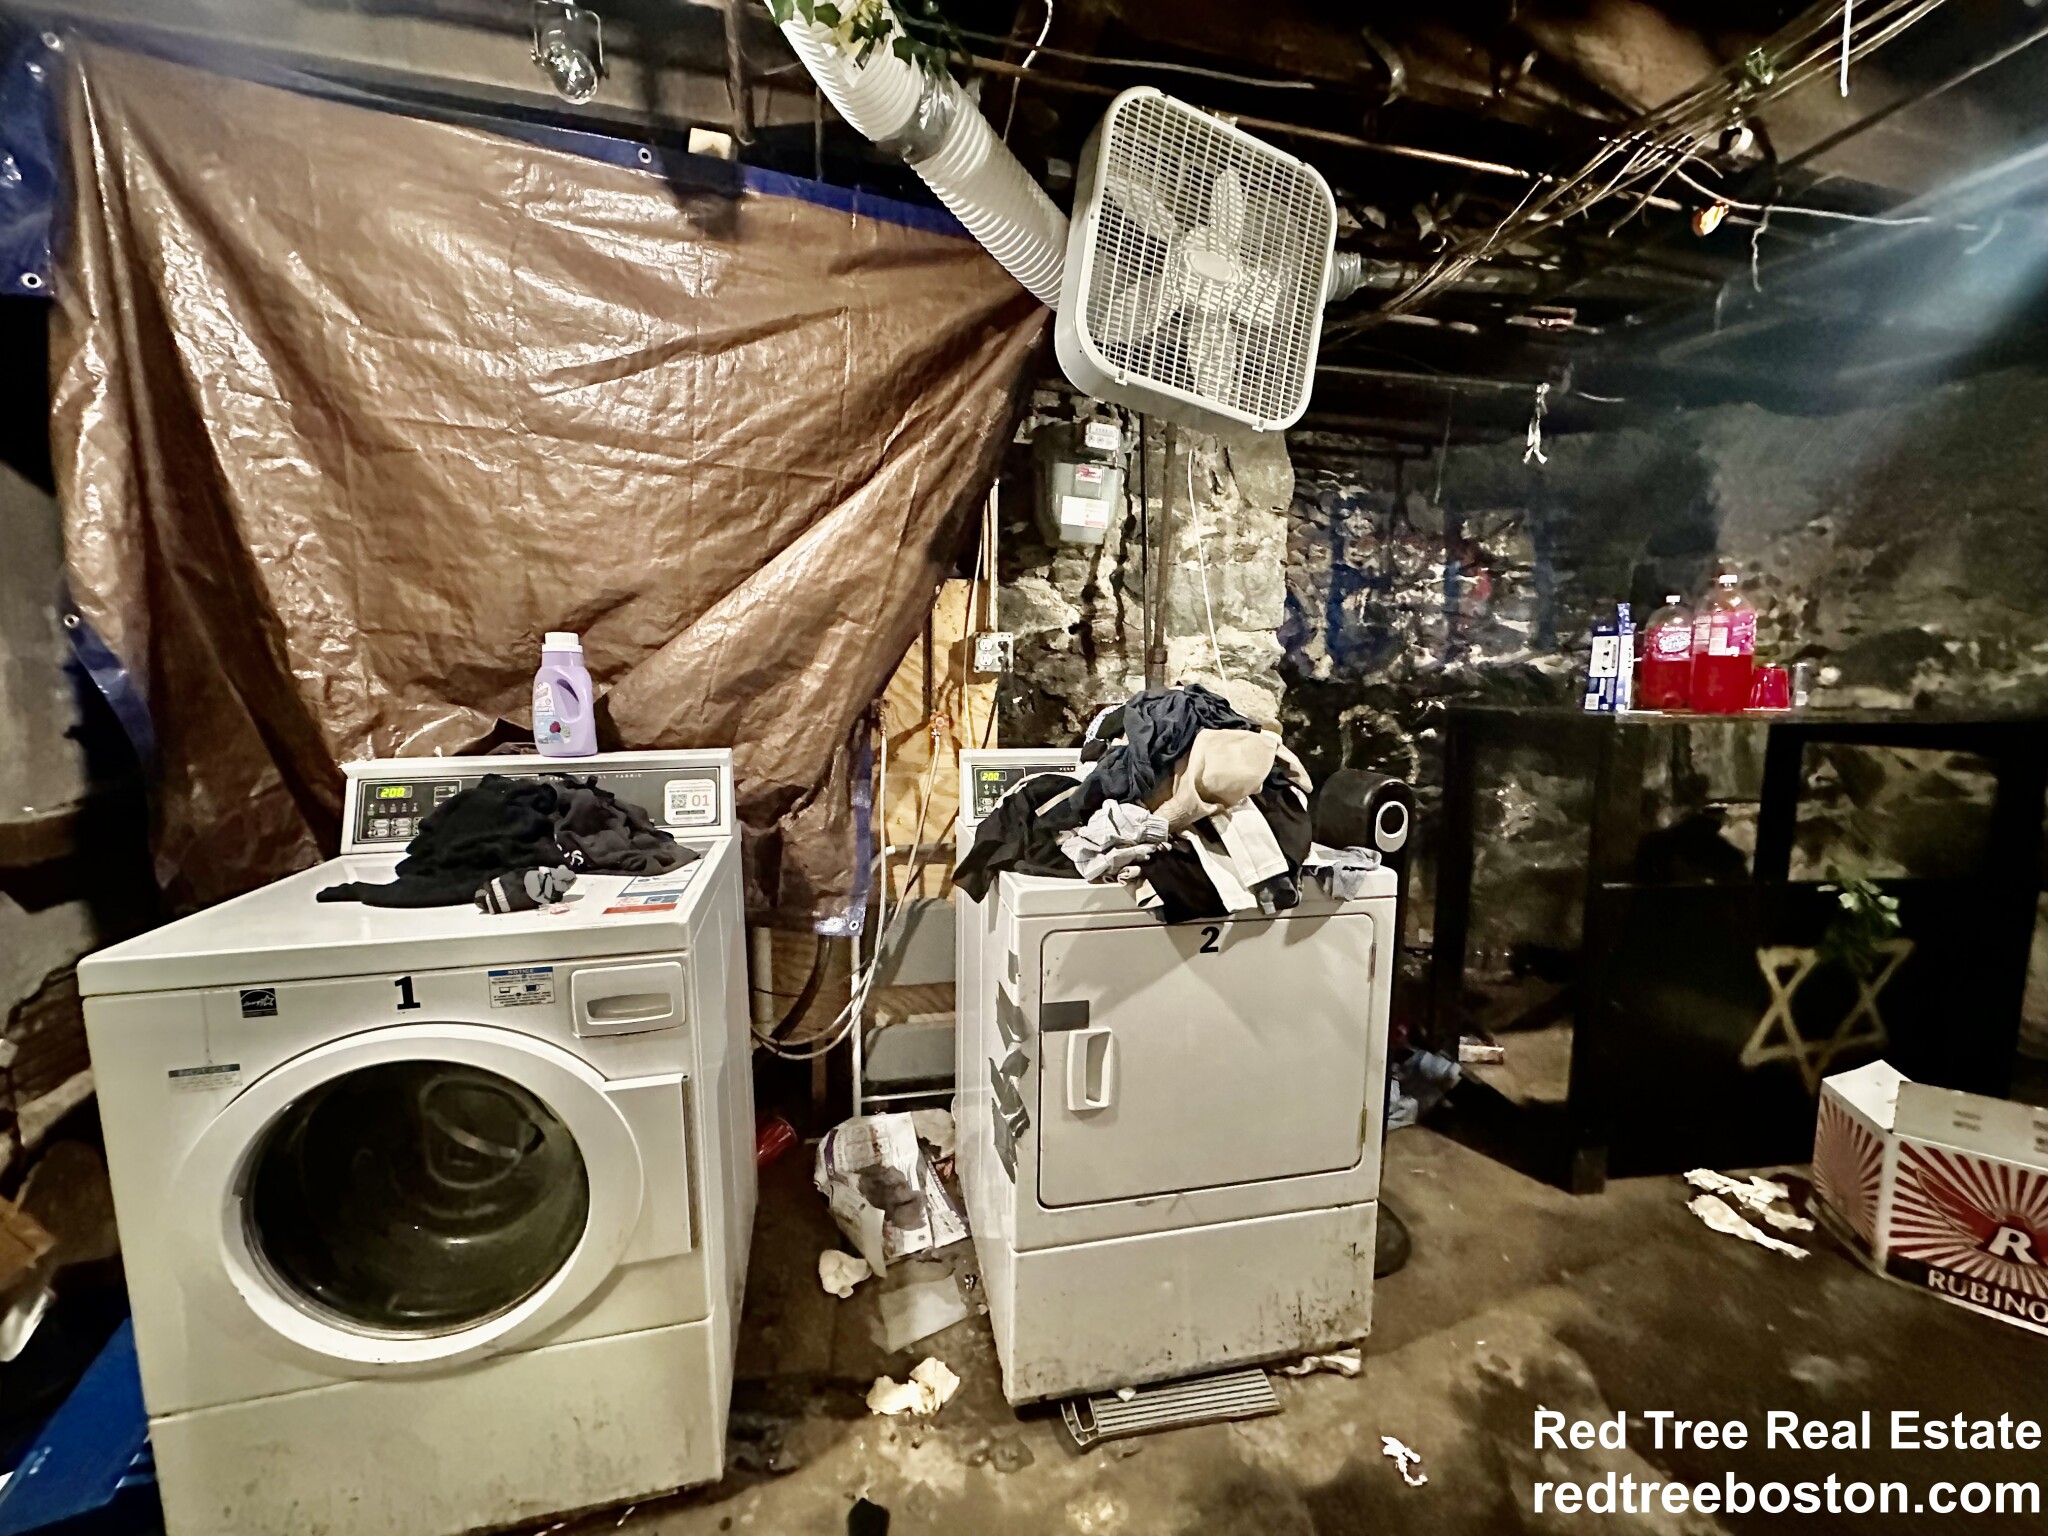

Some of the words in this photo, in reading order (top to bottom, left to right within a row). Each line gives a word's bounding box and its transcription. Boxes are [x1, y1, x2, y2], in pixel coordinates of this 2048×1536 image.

[982, 772, 999, 781] 200
[380, 786, 405, 798] 200
[691, 794, 710, 807] 01
[1200, 926, 1219, 954] 2
[394, 975, 421, 1010] 1
[1988, 1226, 2038, 1265] R
